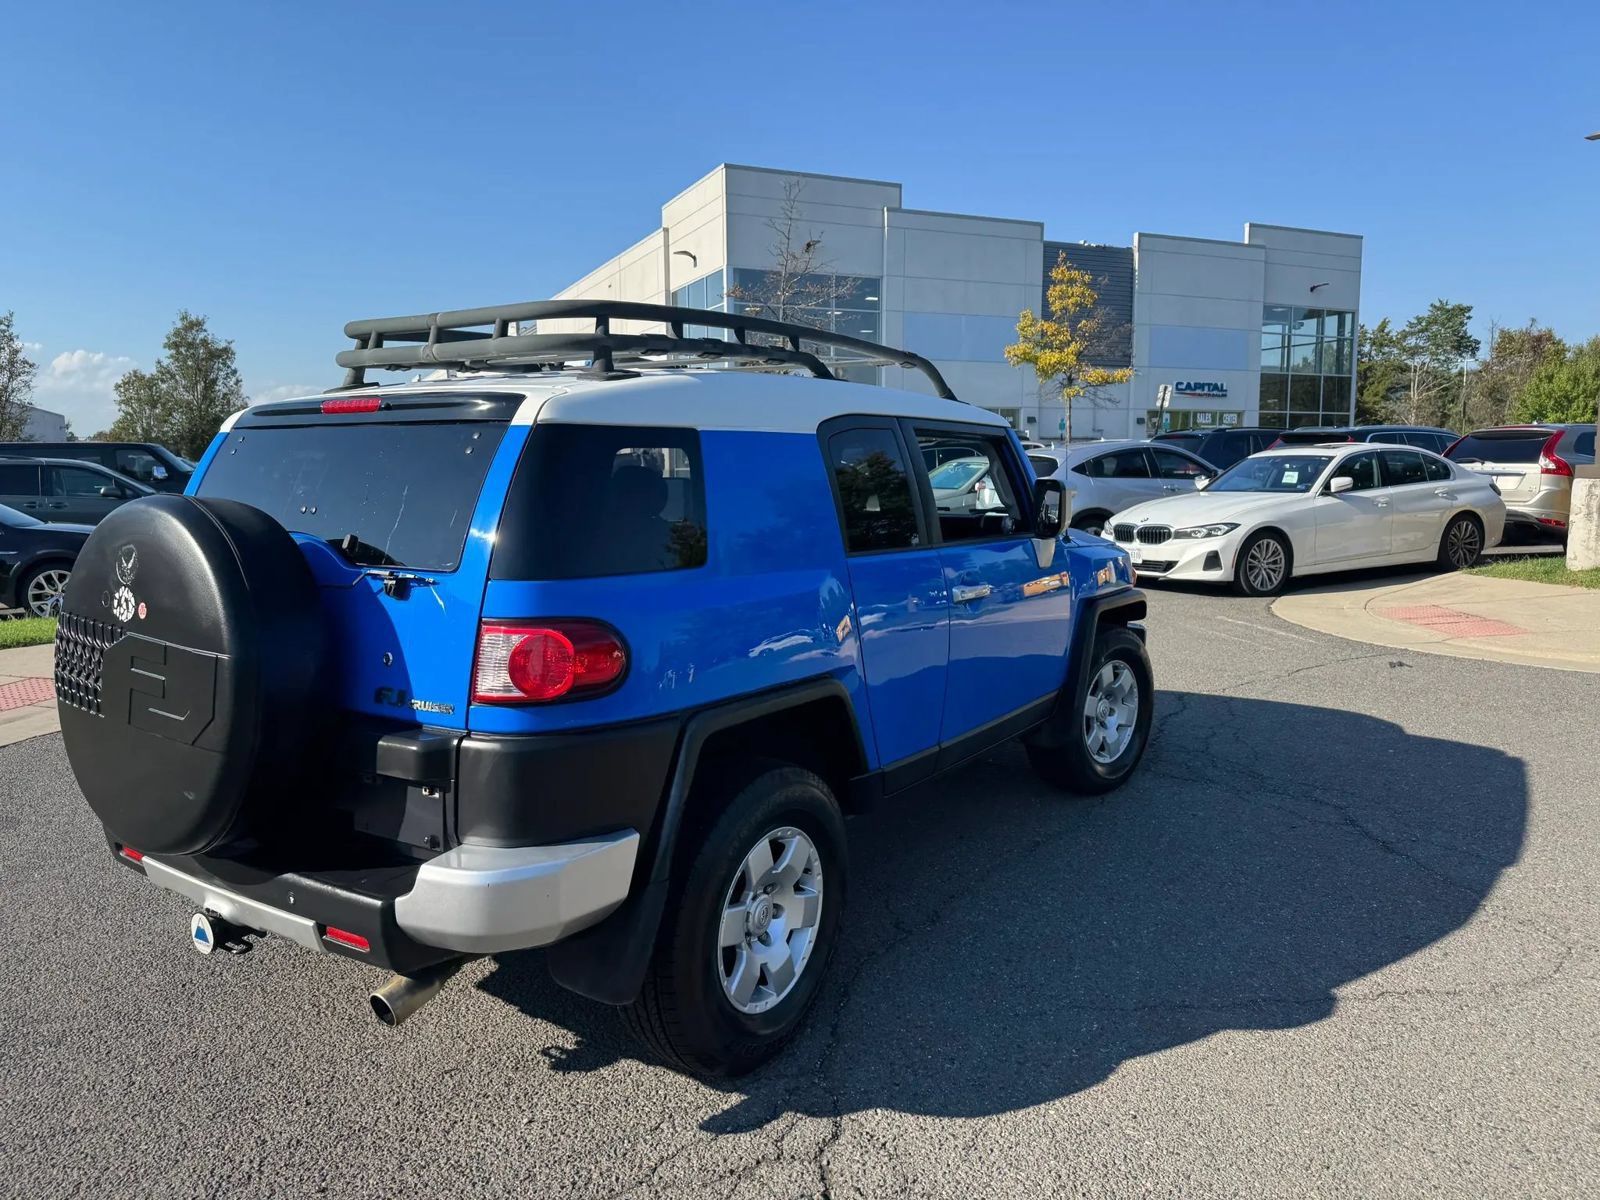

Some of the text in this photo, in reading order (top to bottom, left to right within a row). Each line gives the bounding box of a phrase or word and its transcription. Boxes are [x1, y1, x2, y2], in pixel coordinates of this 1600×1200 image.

[1175, 381, 1228, 393] CAPITAL
[1197, 412, 1212, 424] SALES
[374, 687, 456, 715] FJ CRUISER
